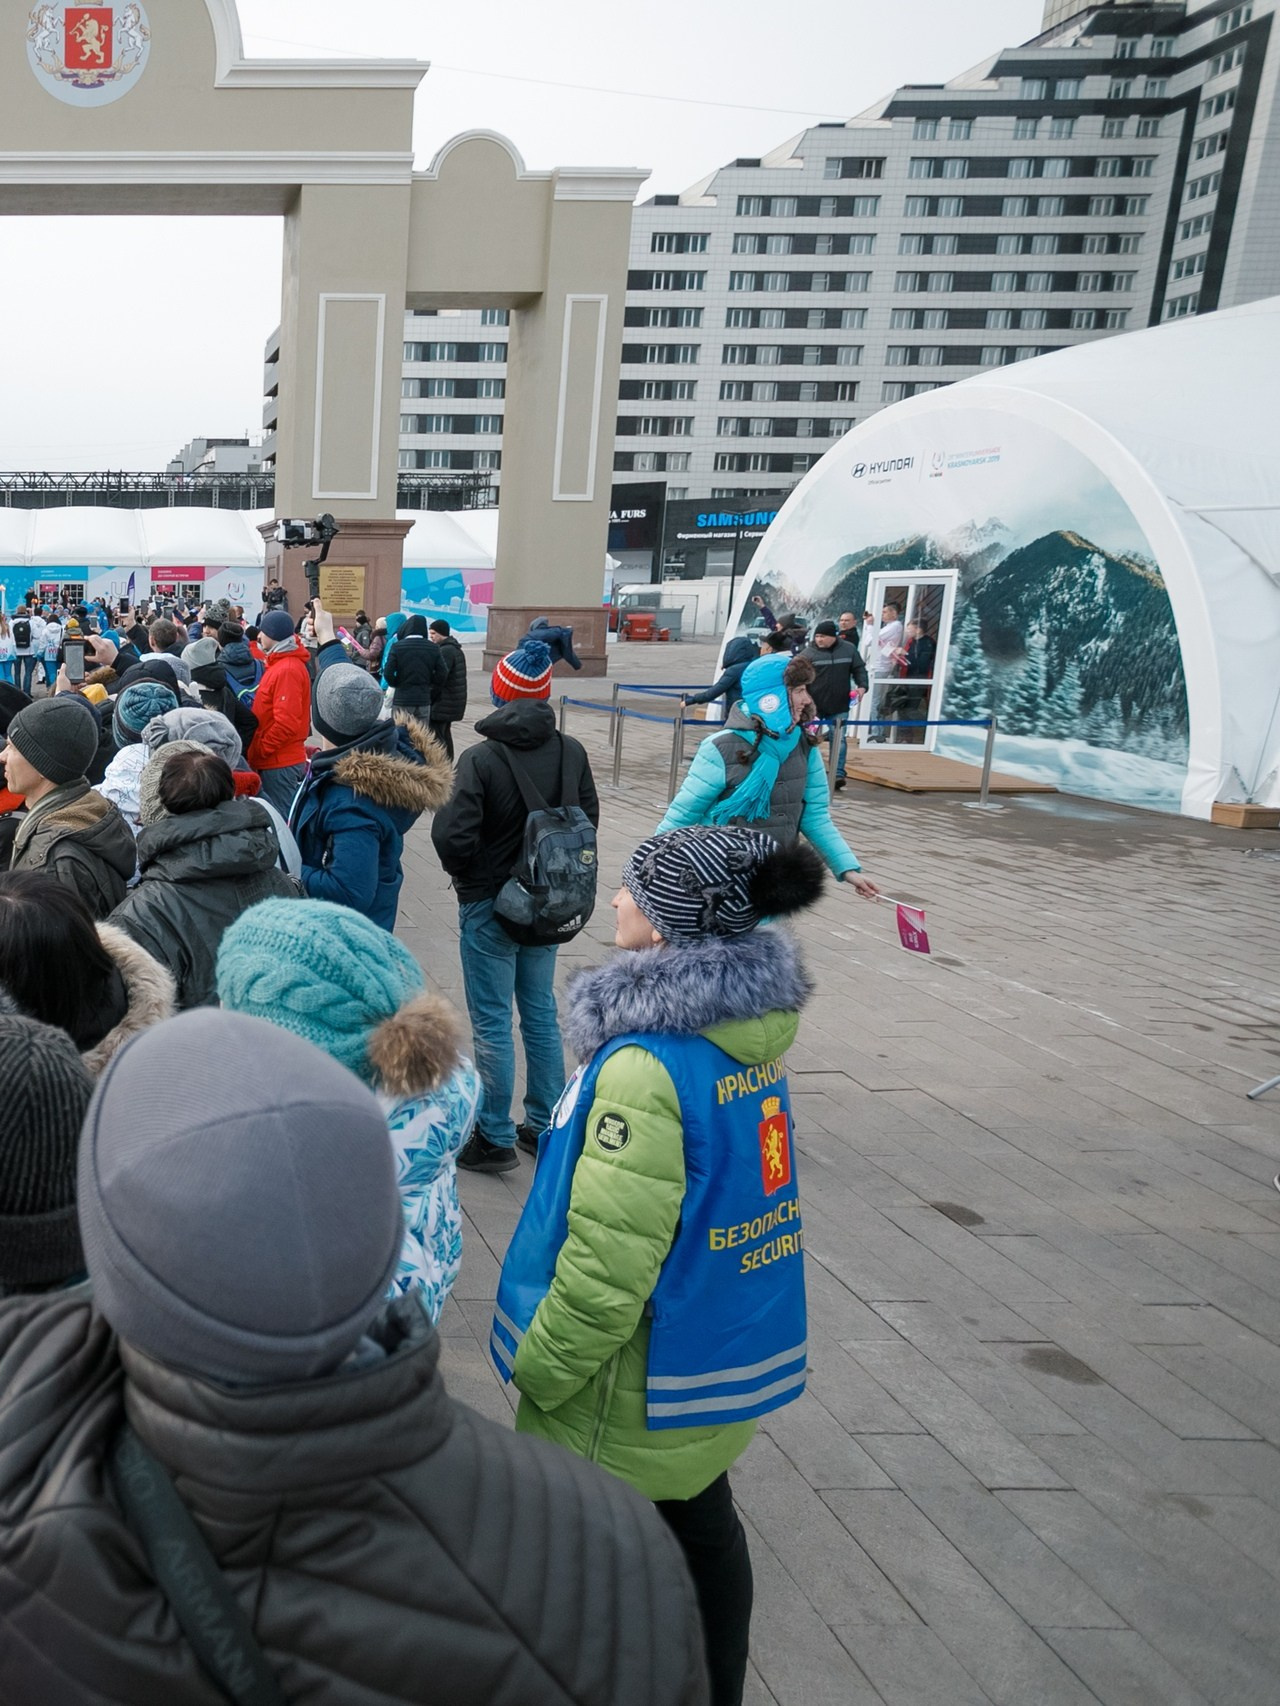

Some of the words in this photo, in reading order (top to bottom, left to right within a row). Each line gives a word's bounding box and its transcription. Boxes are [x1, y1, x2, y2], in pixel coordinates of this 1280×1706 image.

[869, 457, 914, 474] HYUNDAI
[620, 509, 647, 519] FURS
[716, 1054, 786, 1105] КРАСНОЯ
[709, 1198, 800, 1251] БЕЗОПАСН
